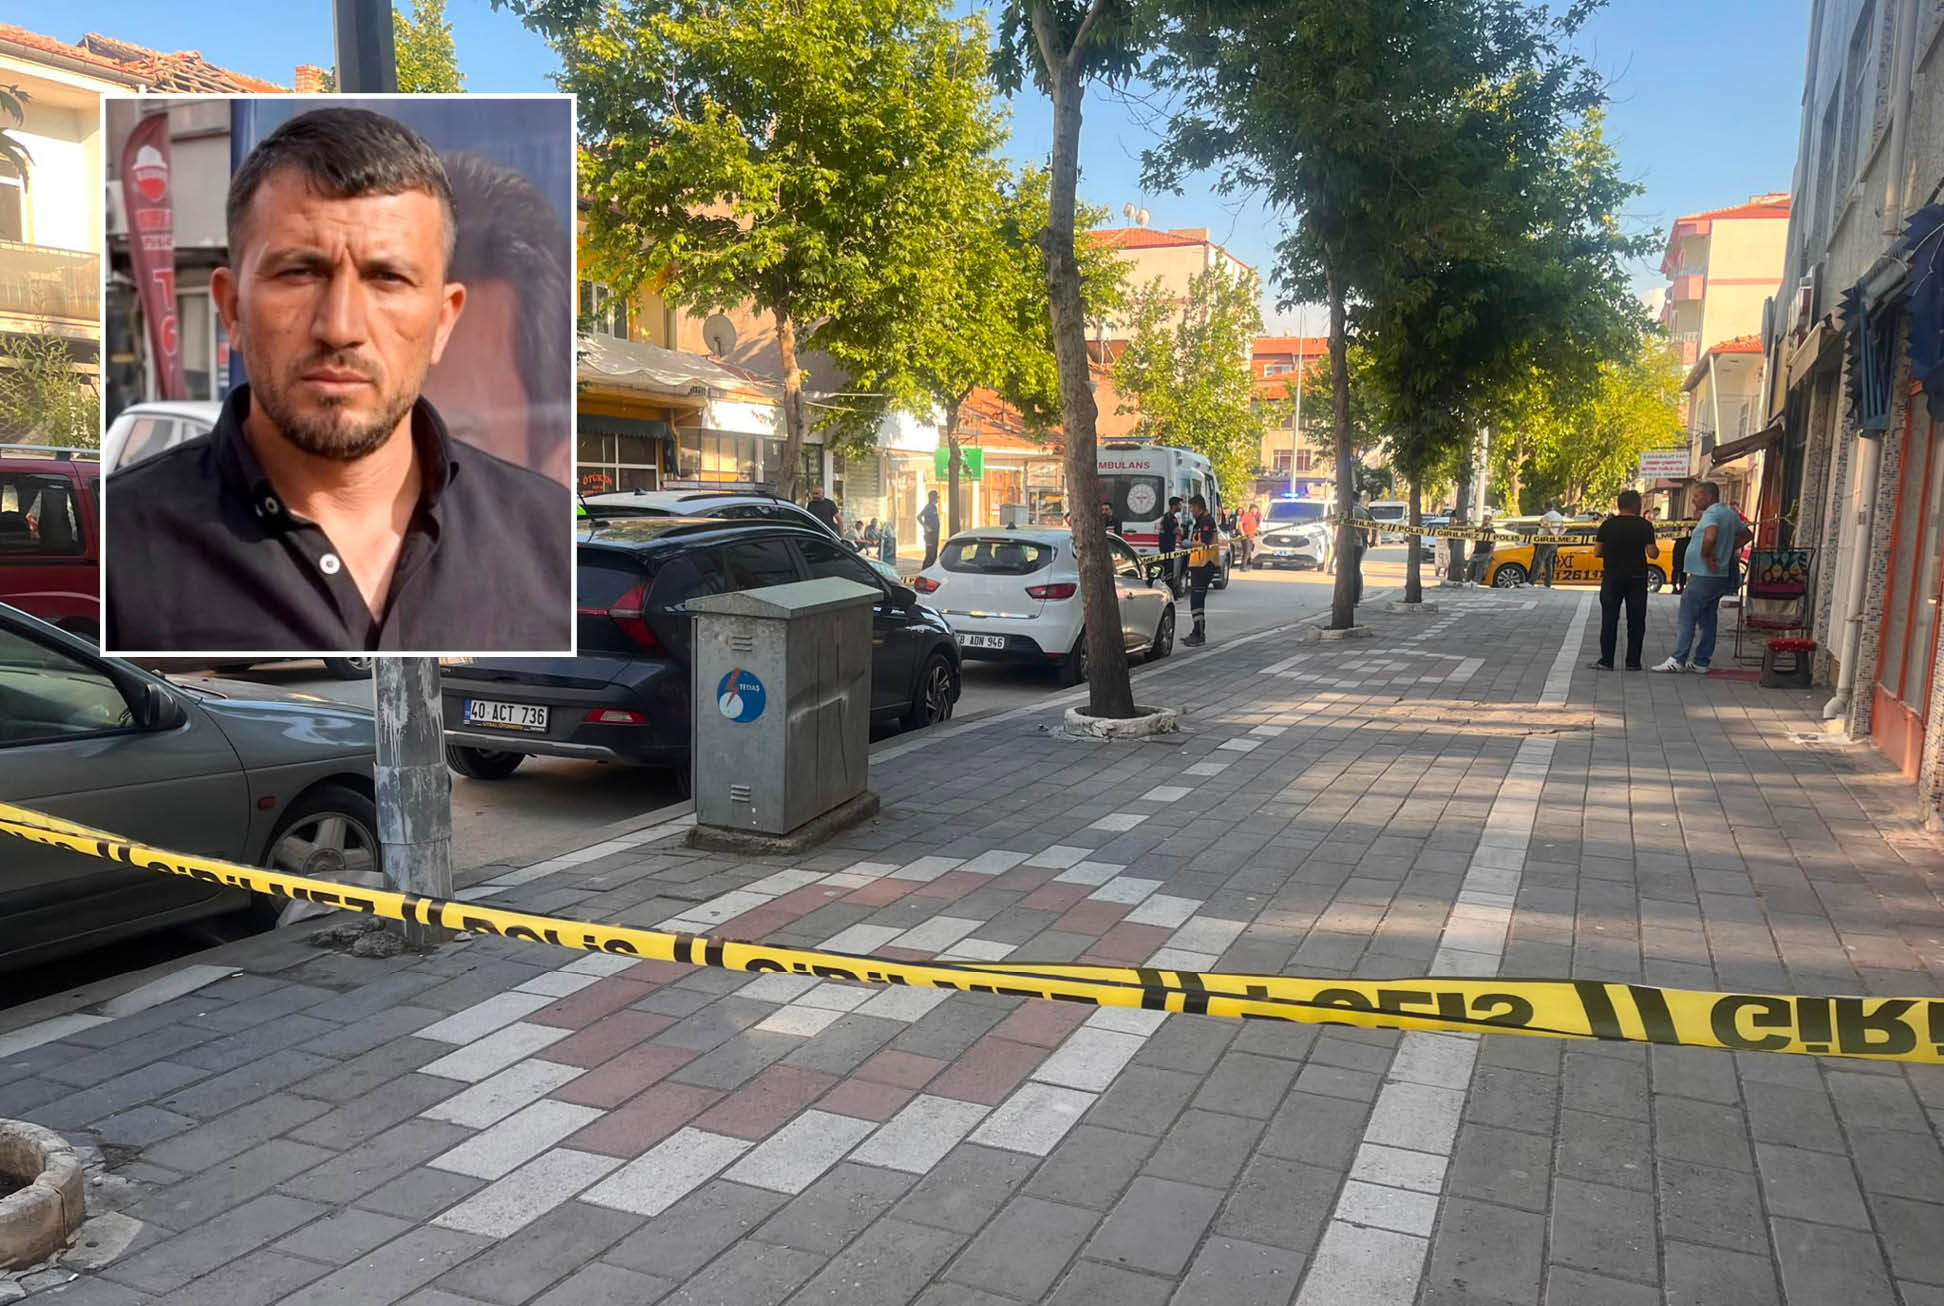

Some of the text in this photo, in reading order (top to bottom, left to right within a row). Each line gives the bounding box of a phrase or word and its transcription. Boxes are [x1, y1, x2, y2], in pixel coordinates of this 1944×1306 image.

[1098, 461, 1150, 470] MBULANS
[987, 636, 1003, 648] 946
[471, 702, 545, 725] 40 ACT 736
